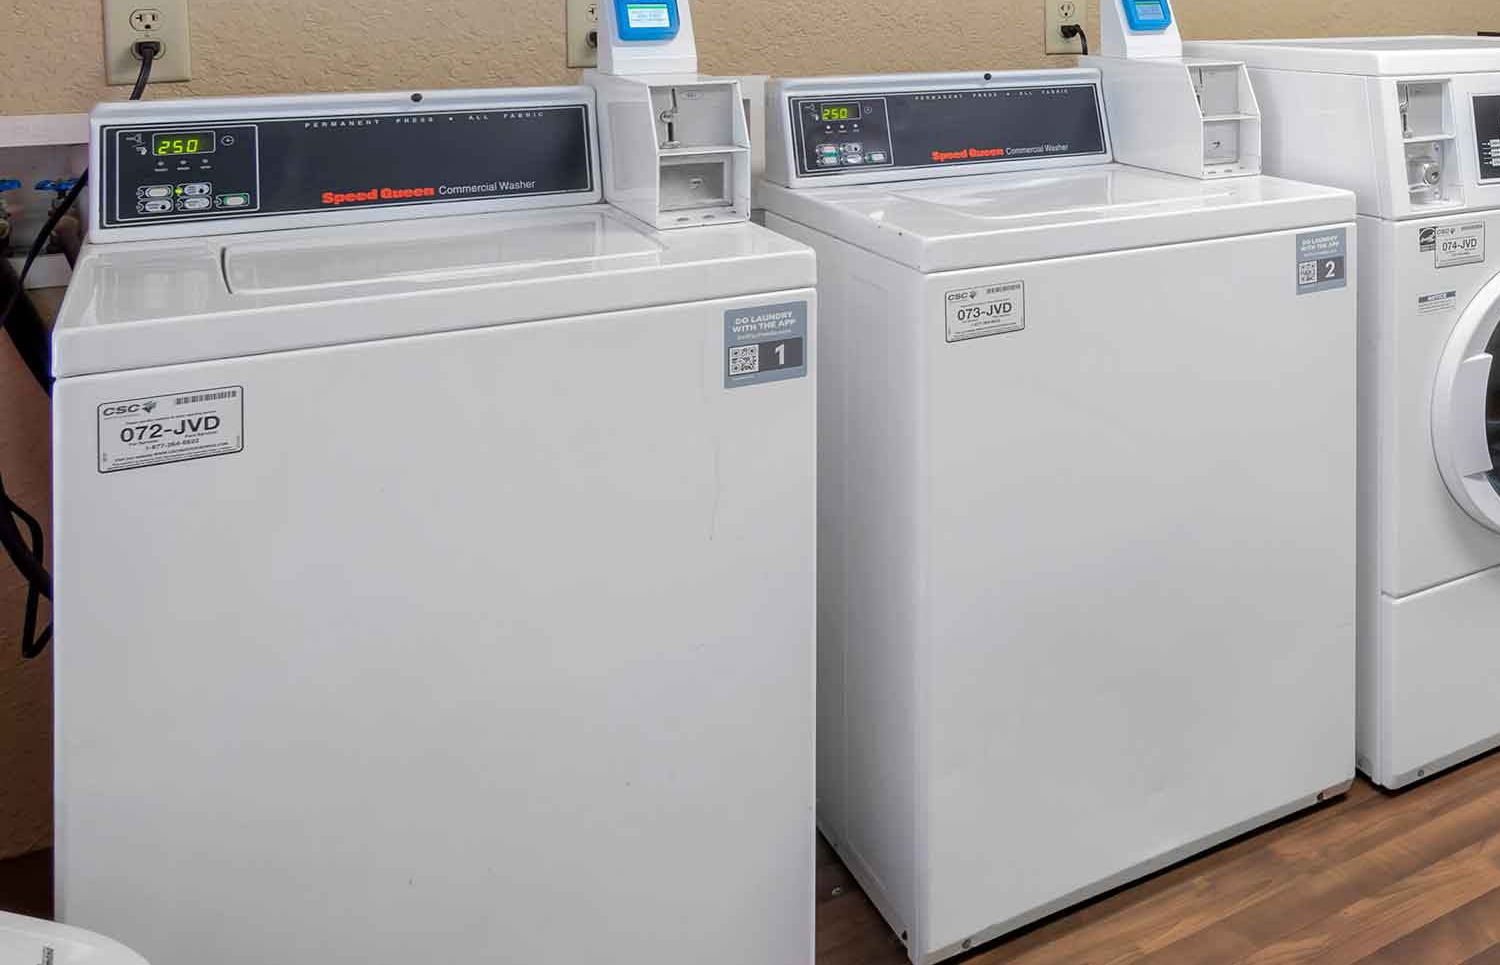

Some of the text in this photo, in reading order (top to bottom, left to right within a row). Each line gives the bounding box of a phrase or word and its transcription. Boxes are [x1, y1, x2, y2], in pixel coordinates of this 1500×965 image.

[304, 118, 381, 129] PERMANENT
[396, 116, 434, 124] PRESS
[503, 111, 544, 119] FABRIC
[823, 108, 848, 120] 250
[158, 139, 199, 155] 250
[931, 144, 1069, 162] Speed Queen Commercial Washer
[321, 179, 537, 204] Speed Queen Commercial Washer
[1442, 238, 1477, 251] 074-JVD
[1325, 260, 1335, 277] 2
[735, 311, 793, 325] DO LAUNDRY
[957, 302, 1012, 321] 073-JVD
[732, 318, 797, 332] WITH THE APP
[775, 344, 784, 364] 1
[103, 404, 141, 416] CSC
[120, 416, 220, 443] 072-JVD
